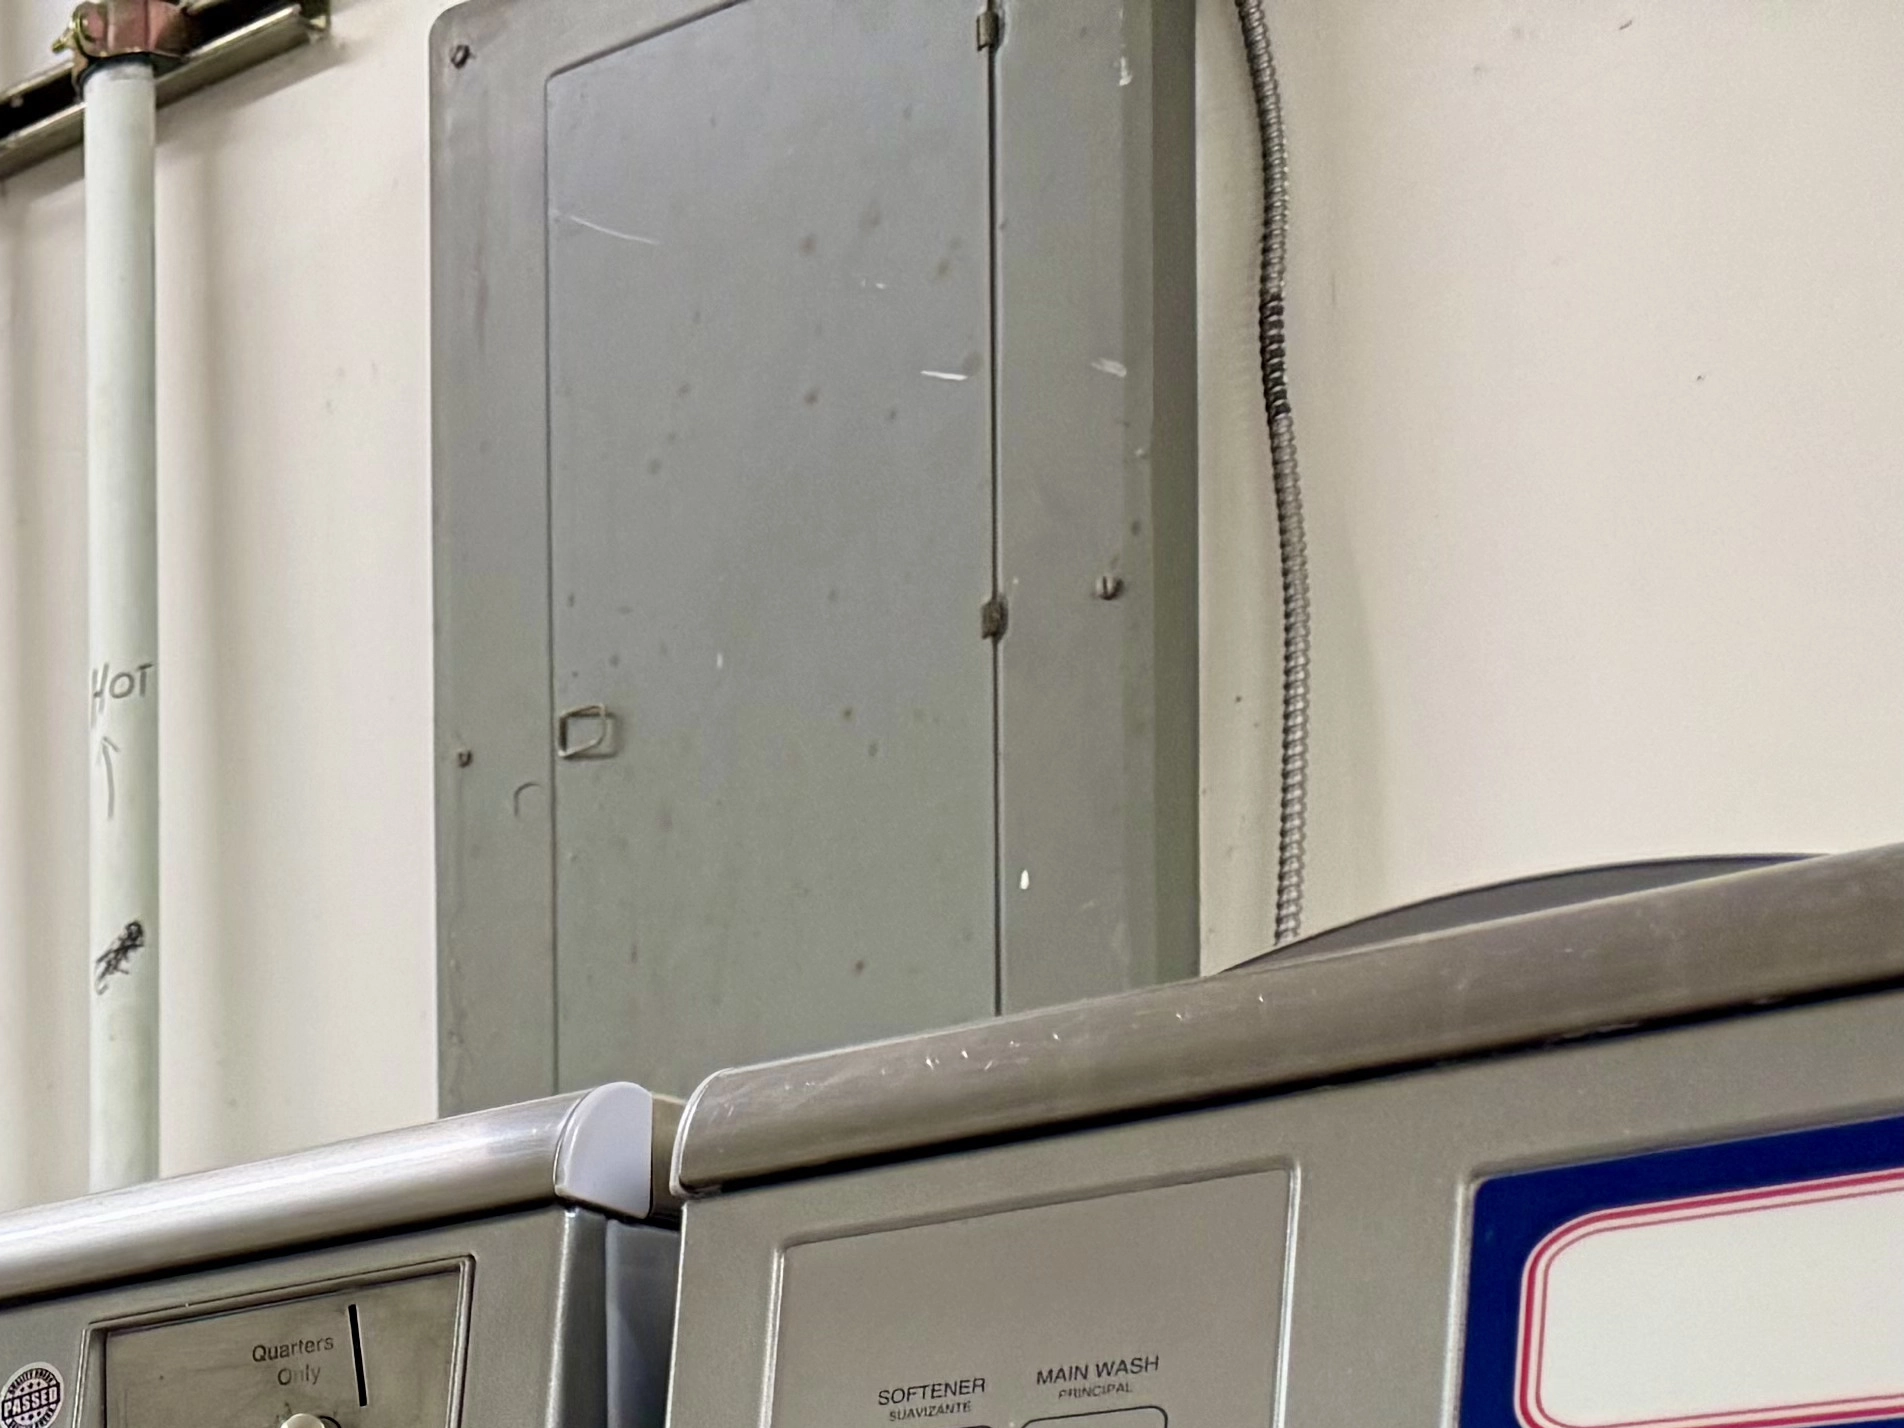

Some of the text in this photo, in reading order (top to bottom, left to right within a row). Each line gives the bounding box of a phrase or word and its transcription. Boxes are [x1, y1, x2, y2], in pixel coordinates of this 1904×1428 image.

[252, 1337, 334, 1362] Quarters
[1036, 1355, 1160, 1386] MAIN WASH
[3, 1387, 58, 1418] PASSED
[878, 1377, 986, 1406] SOFTENER
[1058, 1381, 1133, 1399] PRINCIPAL
[889, 1400, 972, 1422] SUAVIZANTE
